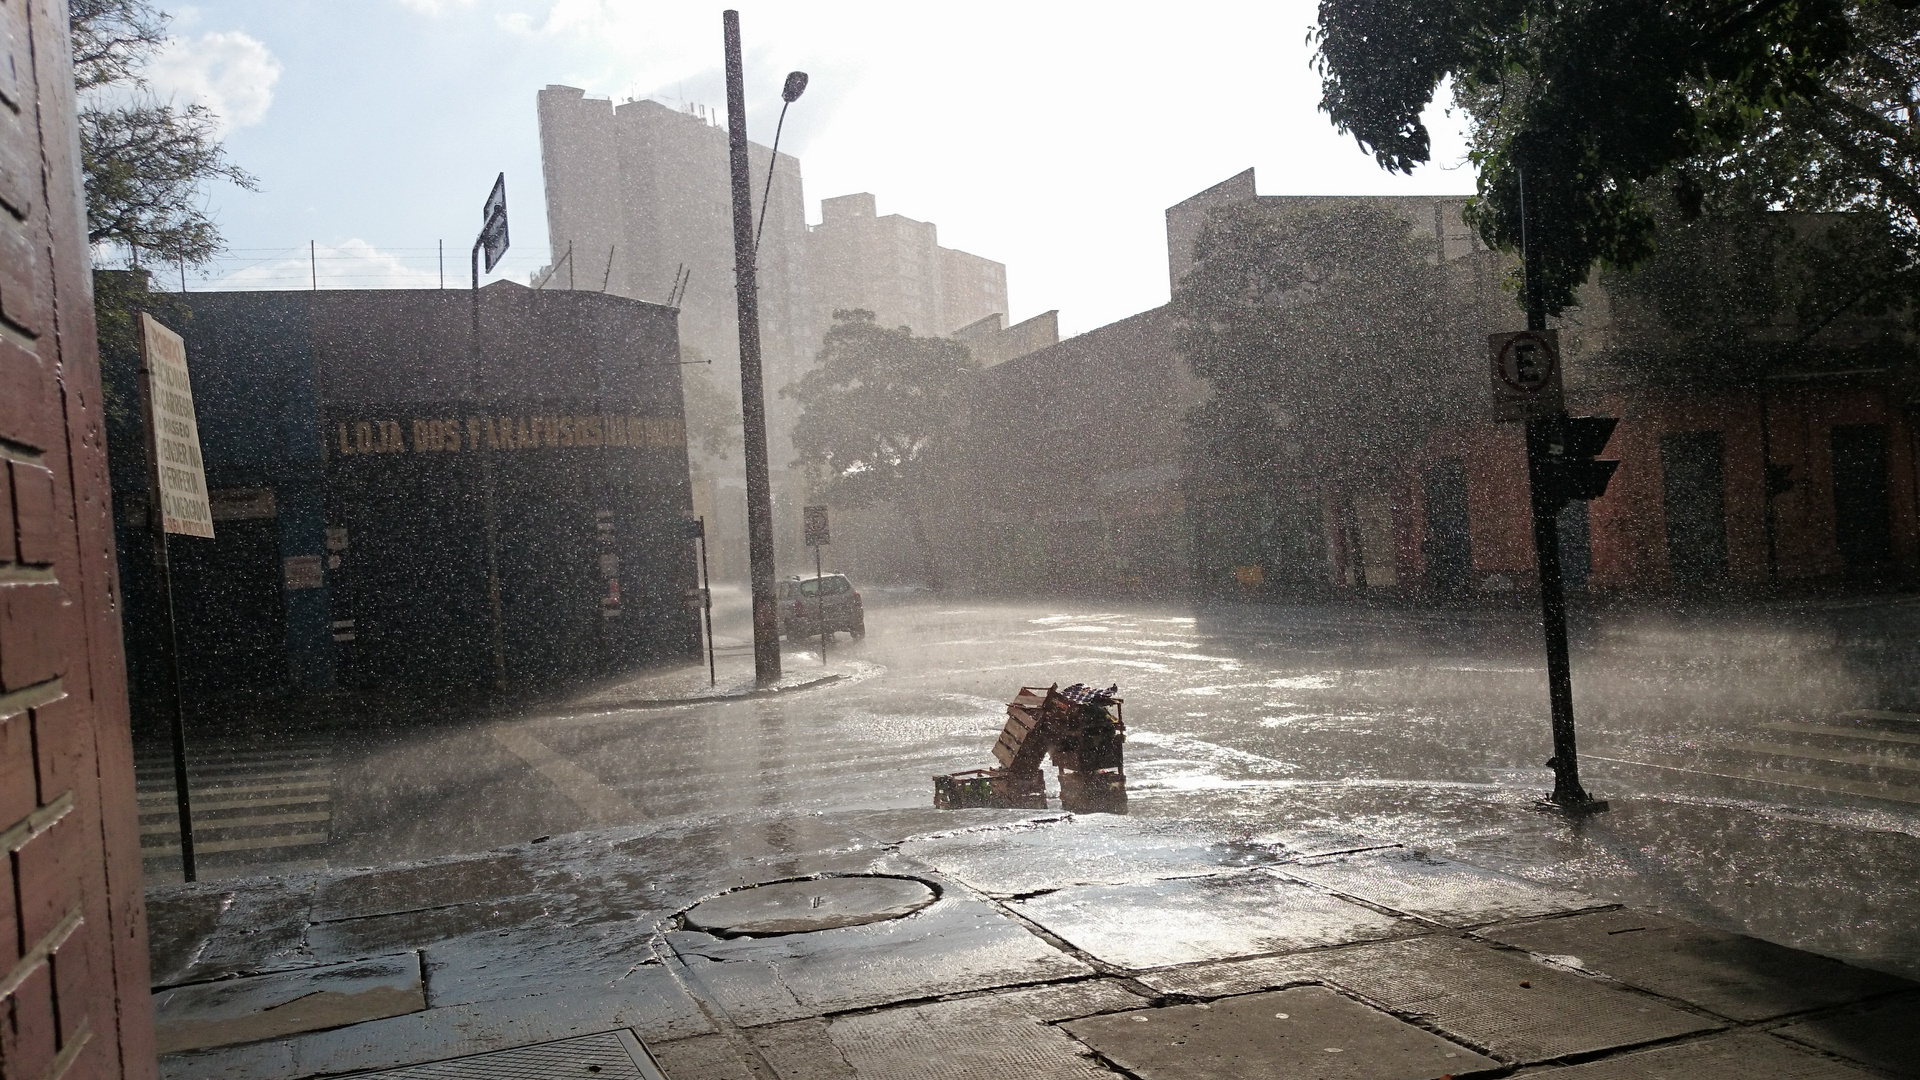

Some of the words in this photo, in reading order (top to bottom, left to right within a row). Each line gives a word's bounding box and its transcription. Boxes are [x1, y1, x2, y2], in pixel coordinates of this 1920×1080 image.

[1515, 344, 1540, 382] E
[163, 417, 190, 439] PASSEIO
[338, 420, 406, 454] LOJA
[413, 418, 462, 453] DOS
[160, 465, 200, 495] PERIFERIA
[172, 495, 207, 522] MERCADO
